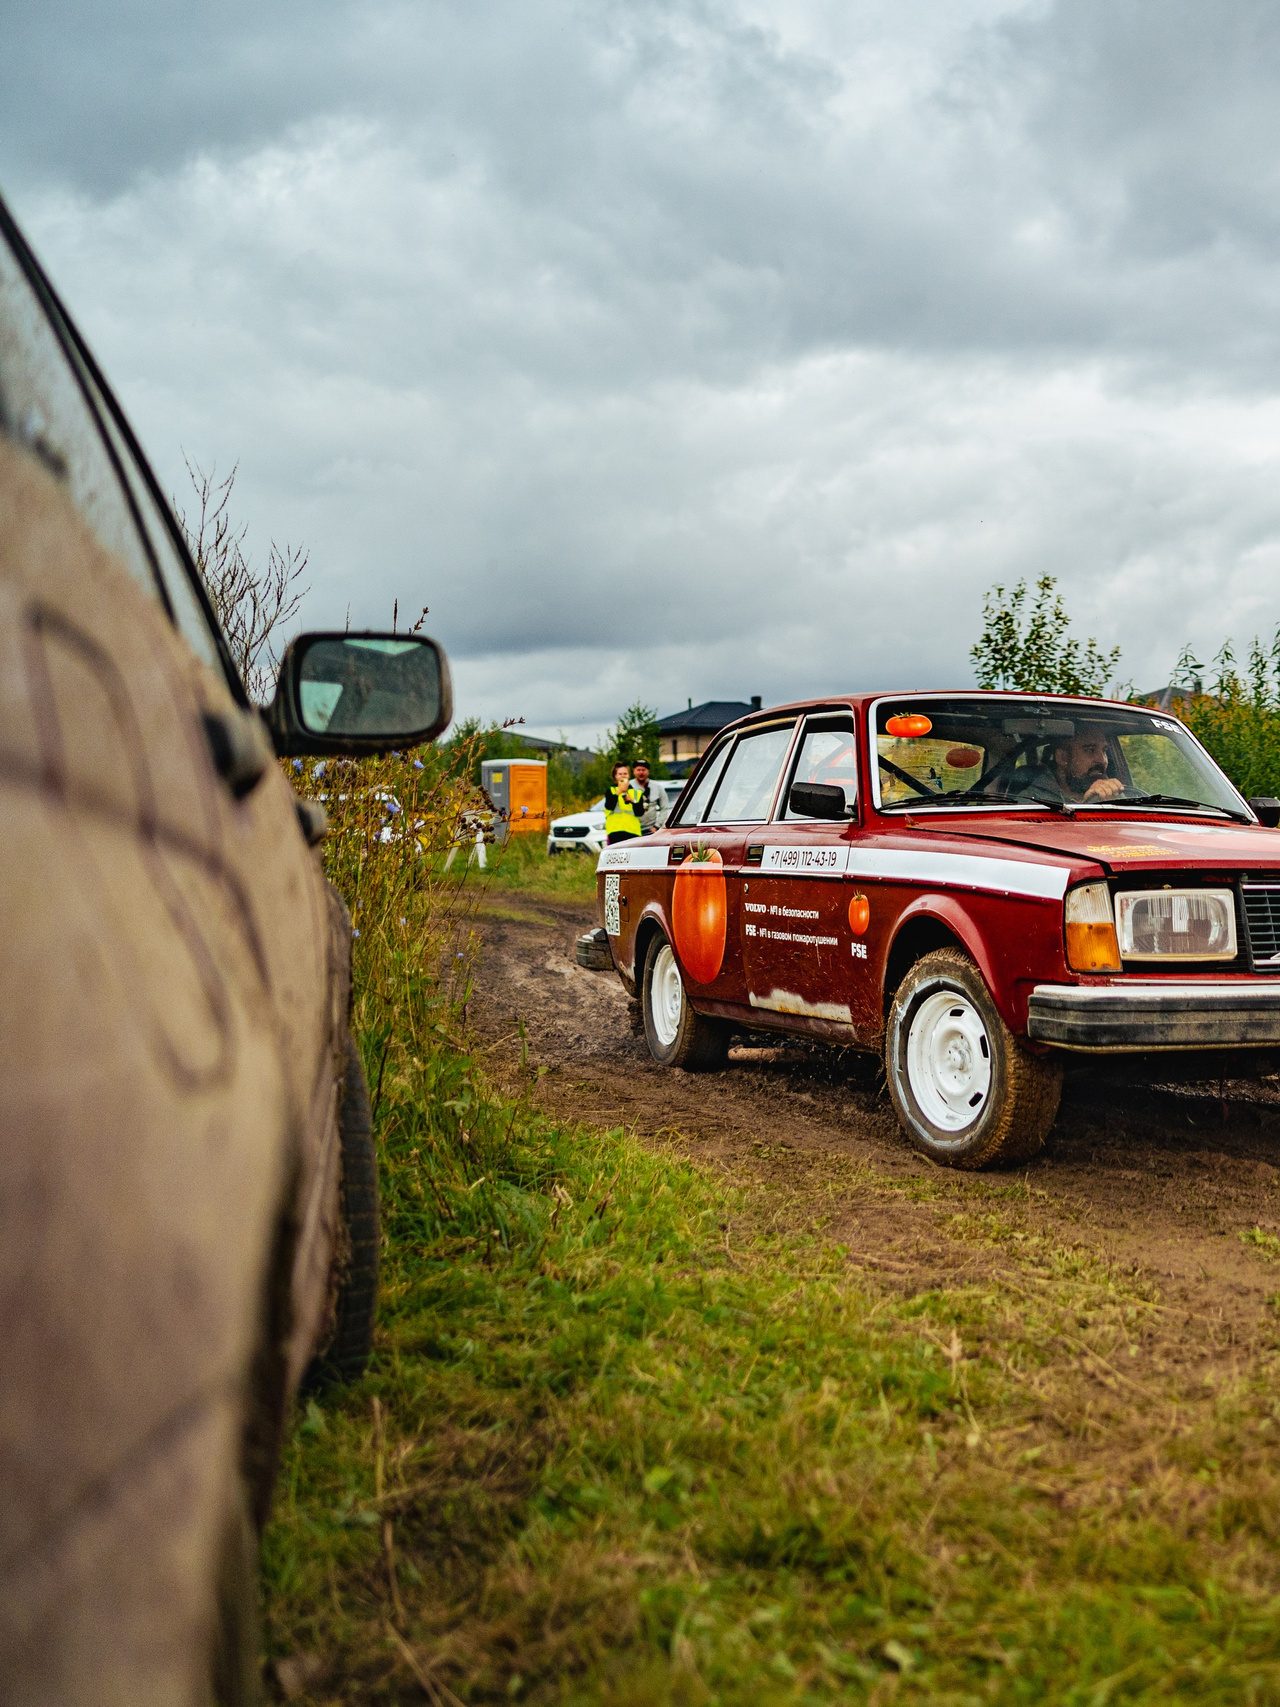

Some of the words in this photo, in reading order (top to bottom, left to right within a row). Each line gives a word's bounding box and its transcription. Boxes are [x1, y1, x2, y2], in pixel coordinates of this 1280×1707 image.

[1150, 718, 1183, 735] FSE
[780, 850, 800, 868] (499)
[801, 851, 837, 866] 112-43-19
[745, 902, 766, 913] VOLVO
[782, 905, 819, 919] безопасности
[745, 924, 756, 937] FSE
[771, 931, 792, 941] газовом
[792, 934, 839, 947] пожаротушении
[851, 942, 868, 960] FSE
